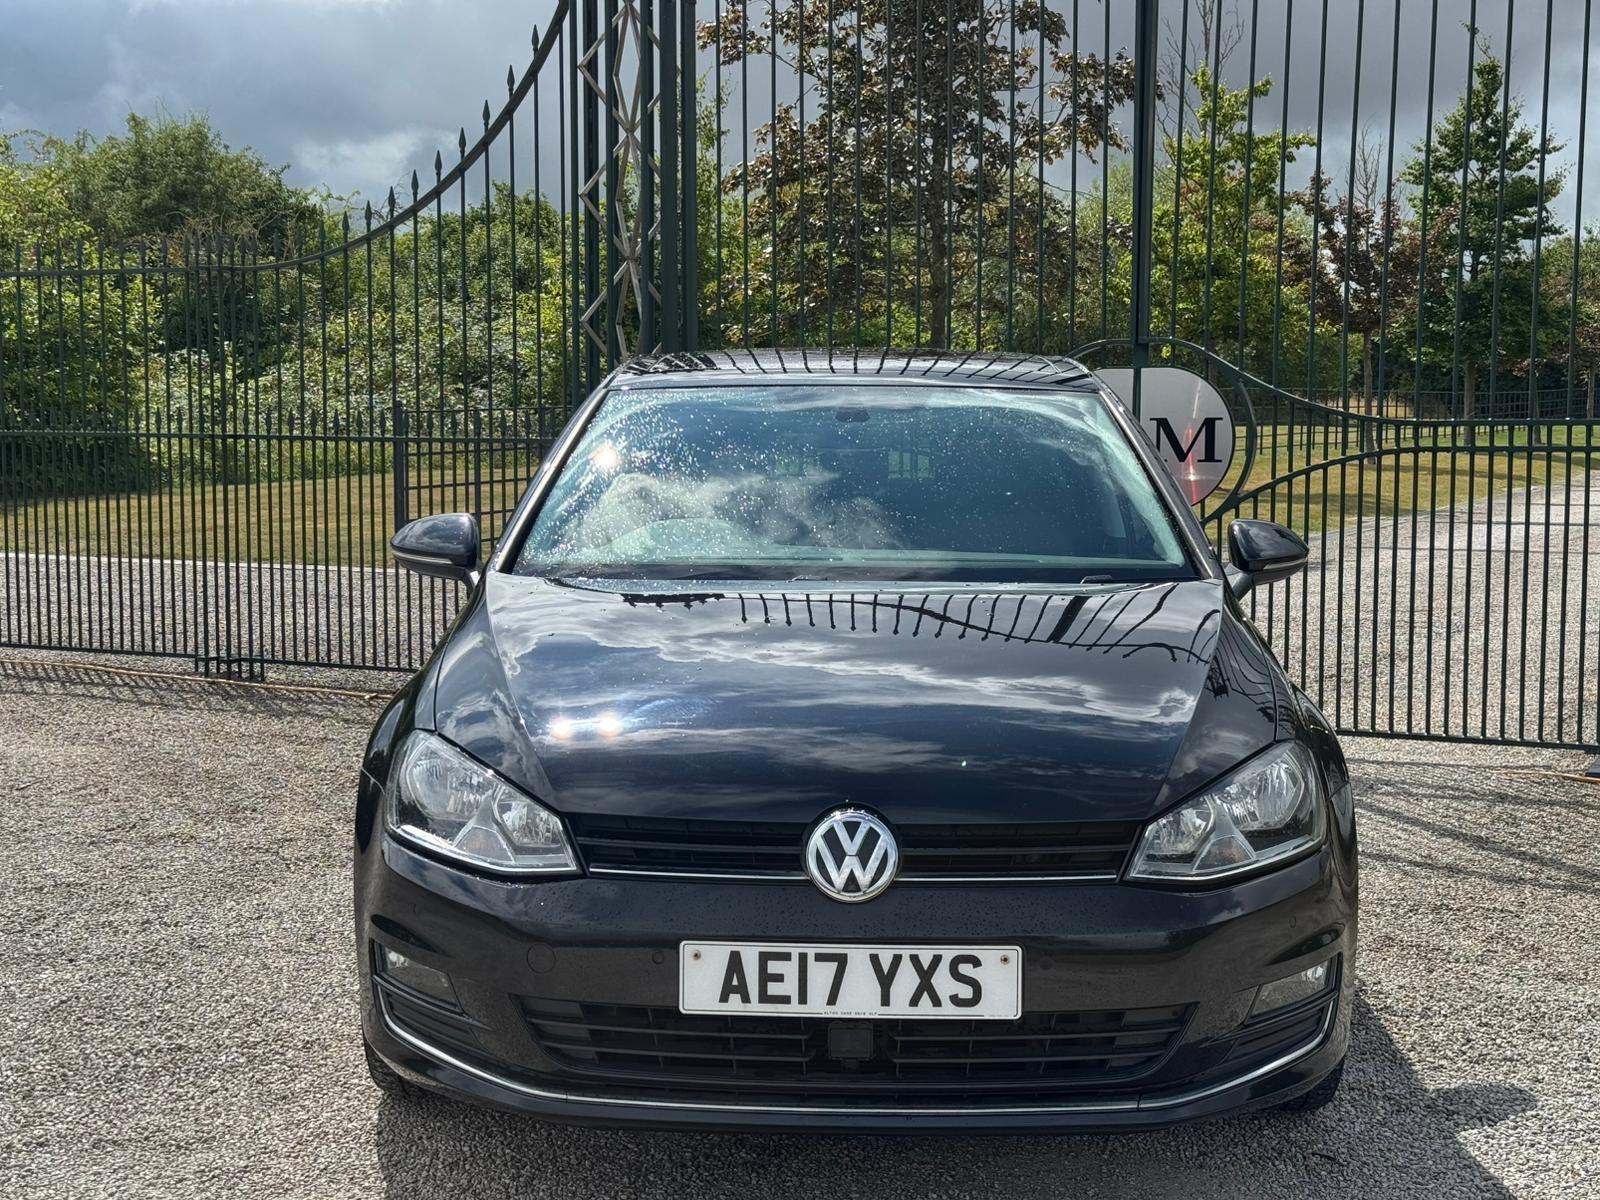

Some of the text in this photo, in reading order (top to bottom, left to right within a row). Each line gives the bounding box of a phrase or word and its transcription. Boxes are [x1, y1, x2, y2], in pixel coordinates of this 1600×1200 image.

[1149, 417, 1223, 463] M
[811, 817, 893, 897] VW
[718, 950, 983, 1008] AE17 YXS
